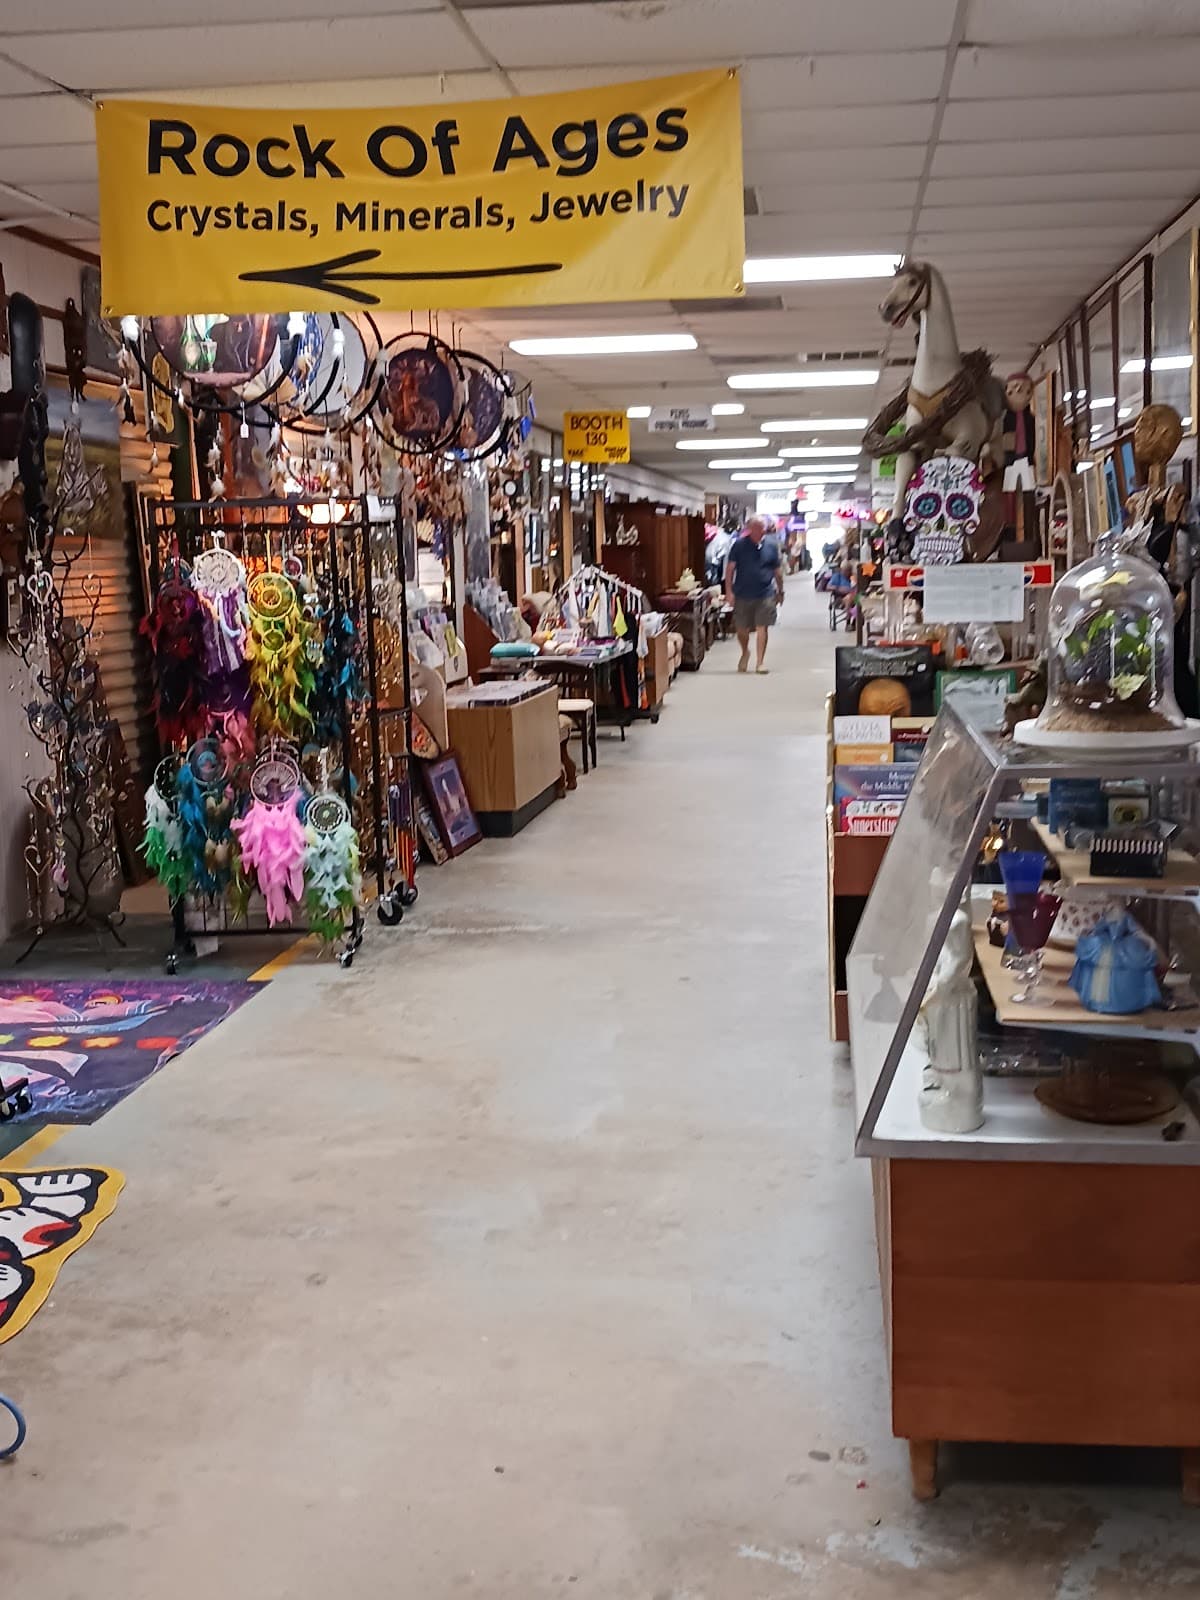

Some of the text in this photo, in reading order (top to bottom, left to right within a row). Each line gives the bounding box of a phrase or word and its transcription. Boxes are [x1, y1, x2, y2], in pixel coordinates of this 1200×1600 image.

[148, 107, 689, 178] Rock Of Ages
[147, 179, 690, 238] Crystals, Minerals, Jewelry
[570, 415, 623, 431] BOOTH
[585, 432, 608, 446] 130
